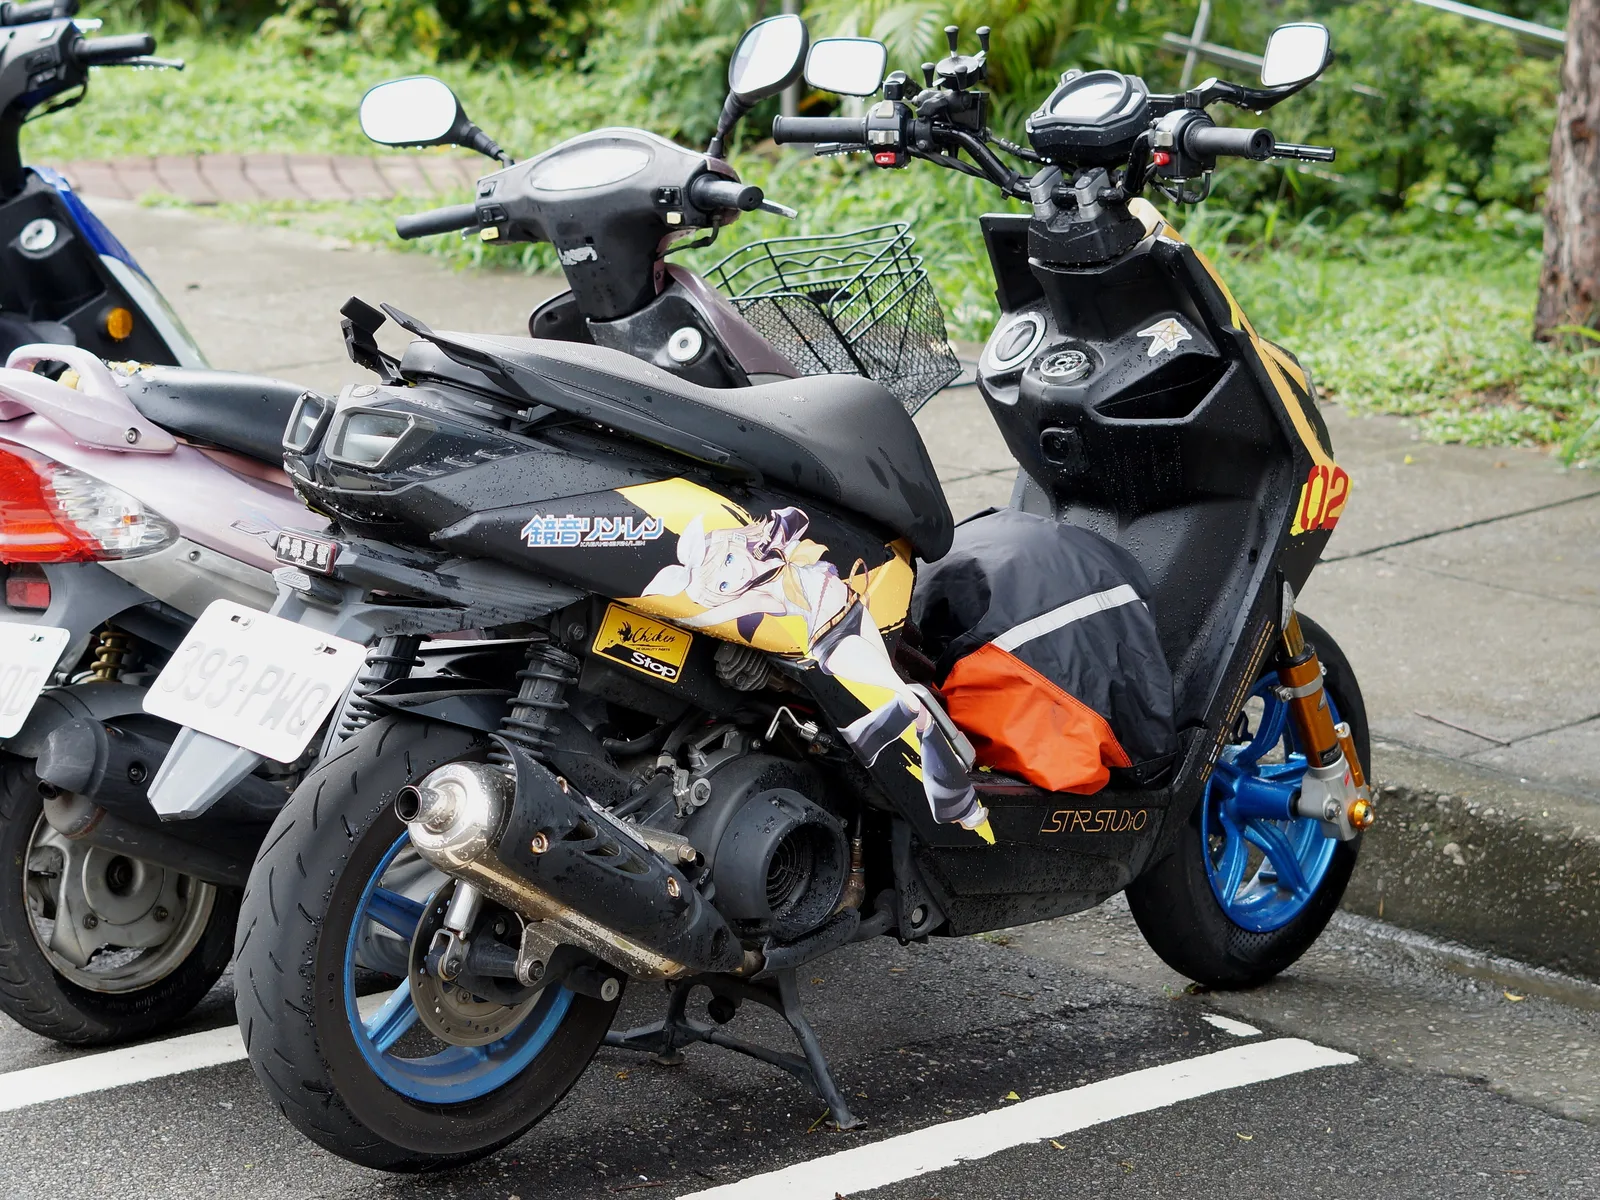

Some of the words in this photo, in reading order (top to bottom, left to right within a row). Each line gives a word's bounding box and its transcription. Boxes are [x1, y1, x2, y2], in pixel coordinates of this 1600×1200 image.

[1301, 465, 1348, 530] 02
[631, 626, 676, 643] Chicken
[630, 651, 677, 677] Stop
